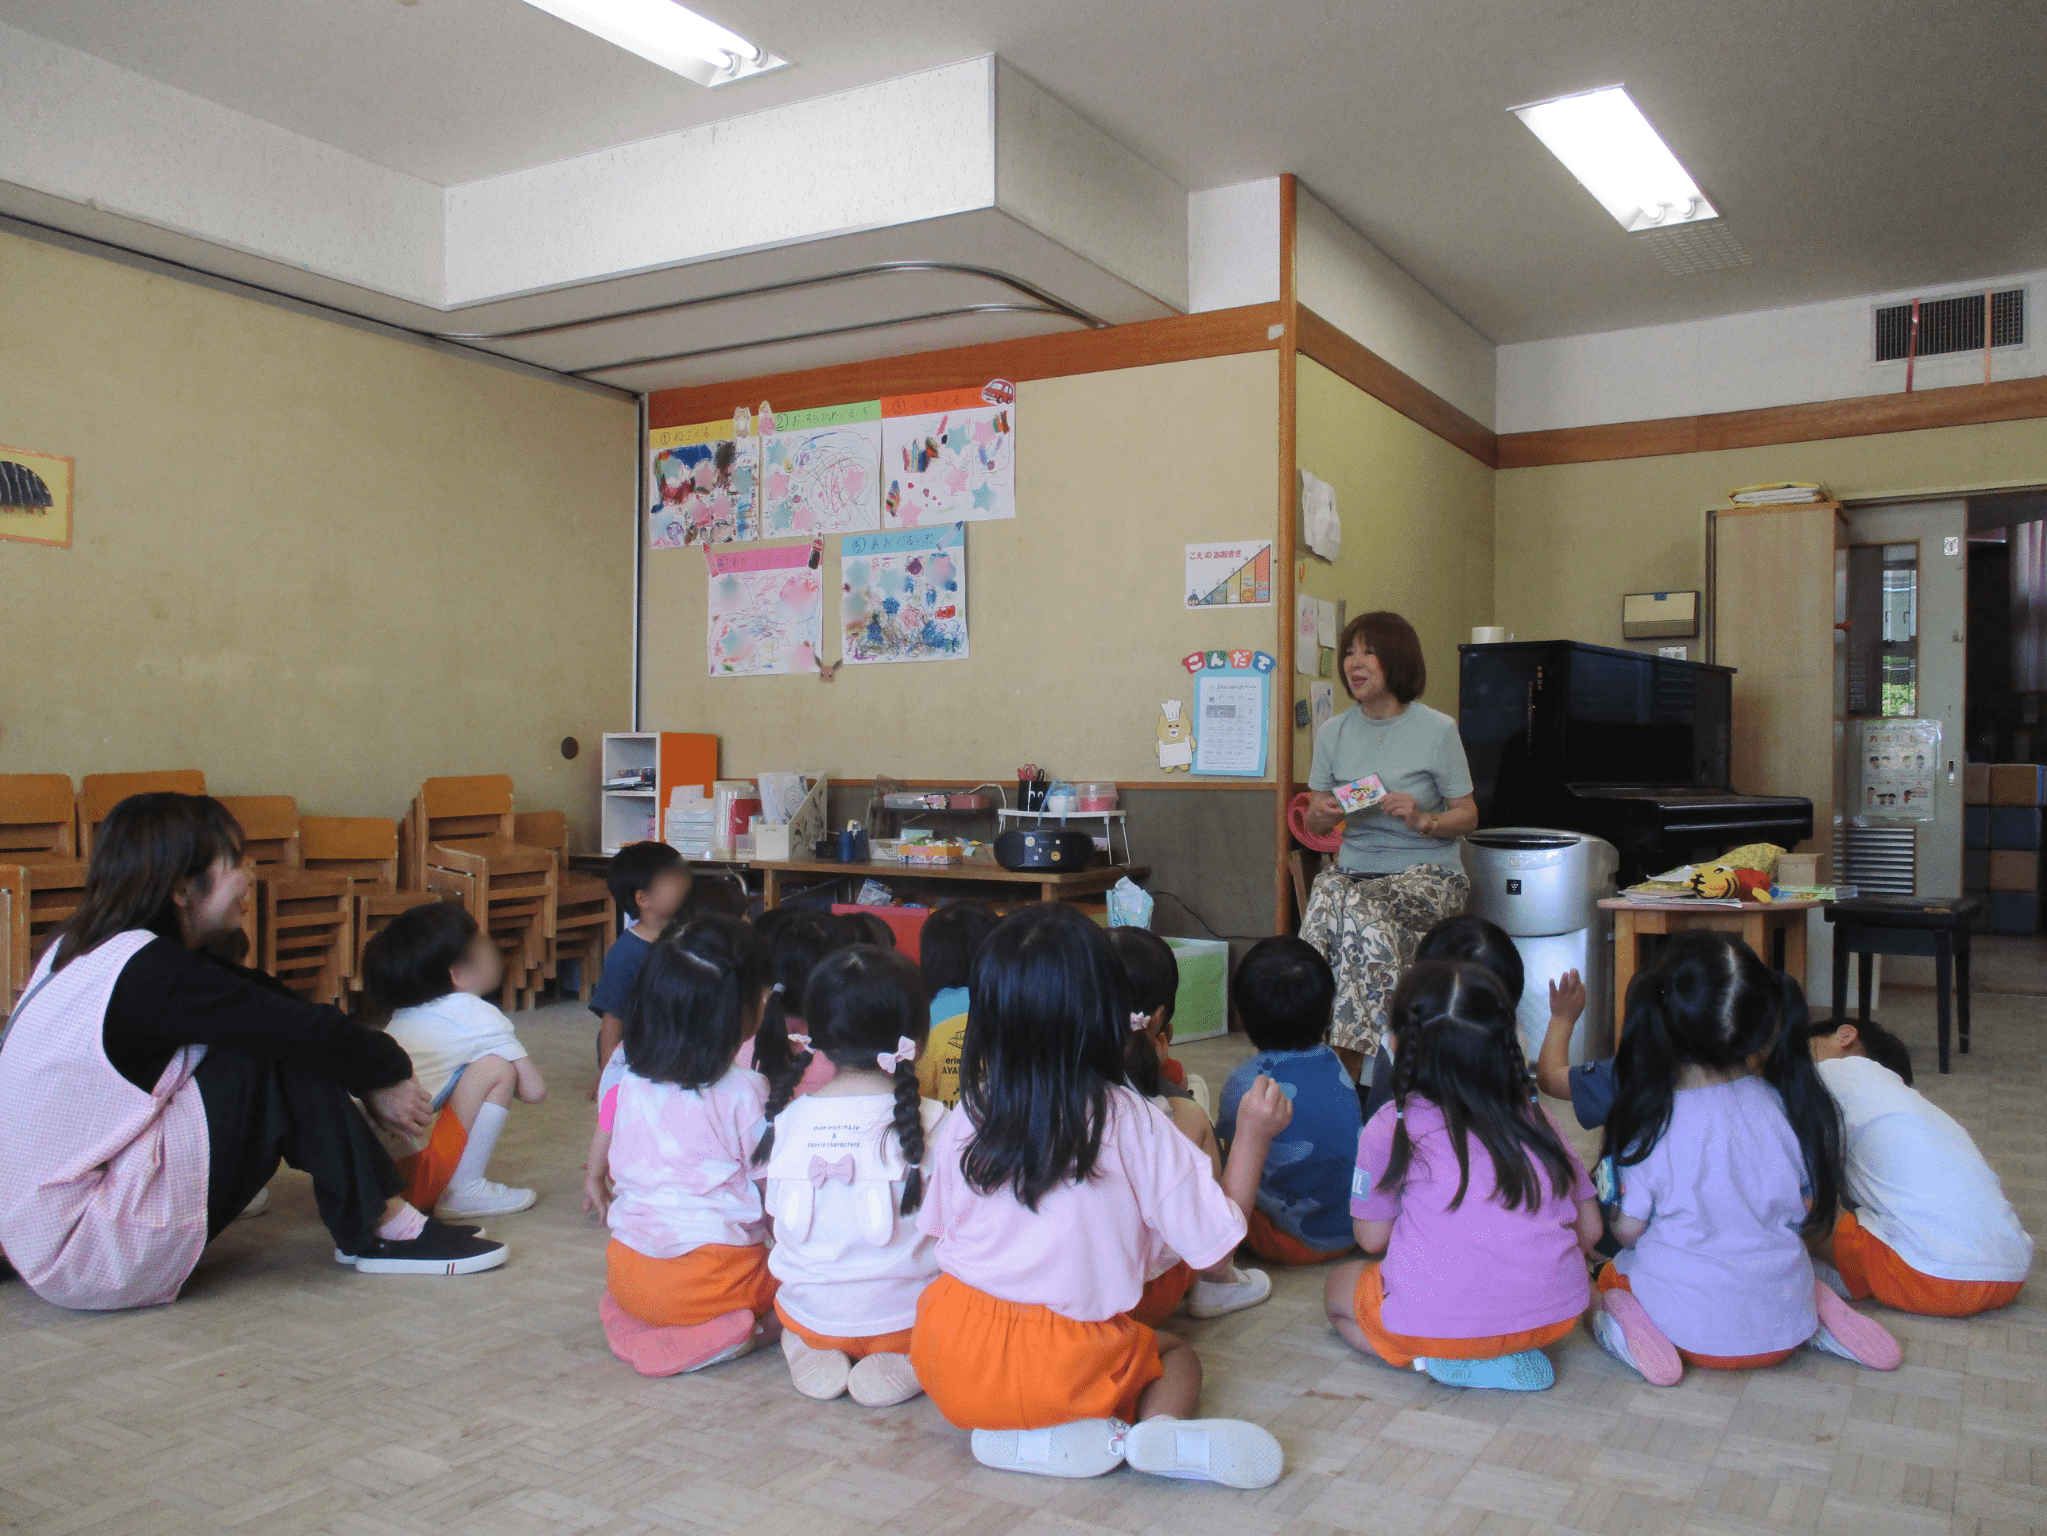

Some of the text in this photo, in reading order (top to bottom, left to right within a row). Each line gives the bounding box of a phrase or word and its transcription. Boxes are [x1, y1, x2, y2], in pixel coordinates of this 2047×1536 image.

[1189, 549, 1242, 560] こえのおおきさ
[1188, 650, 1271, 671] こんだて
[942, 1066, 961, 1075] AYA
